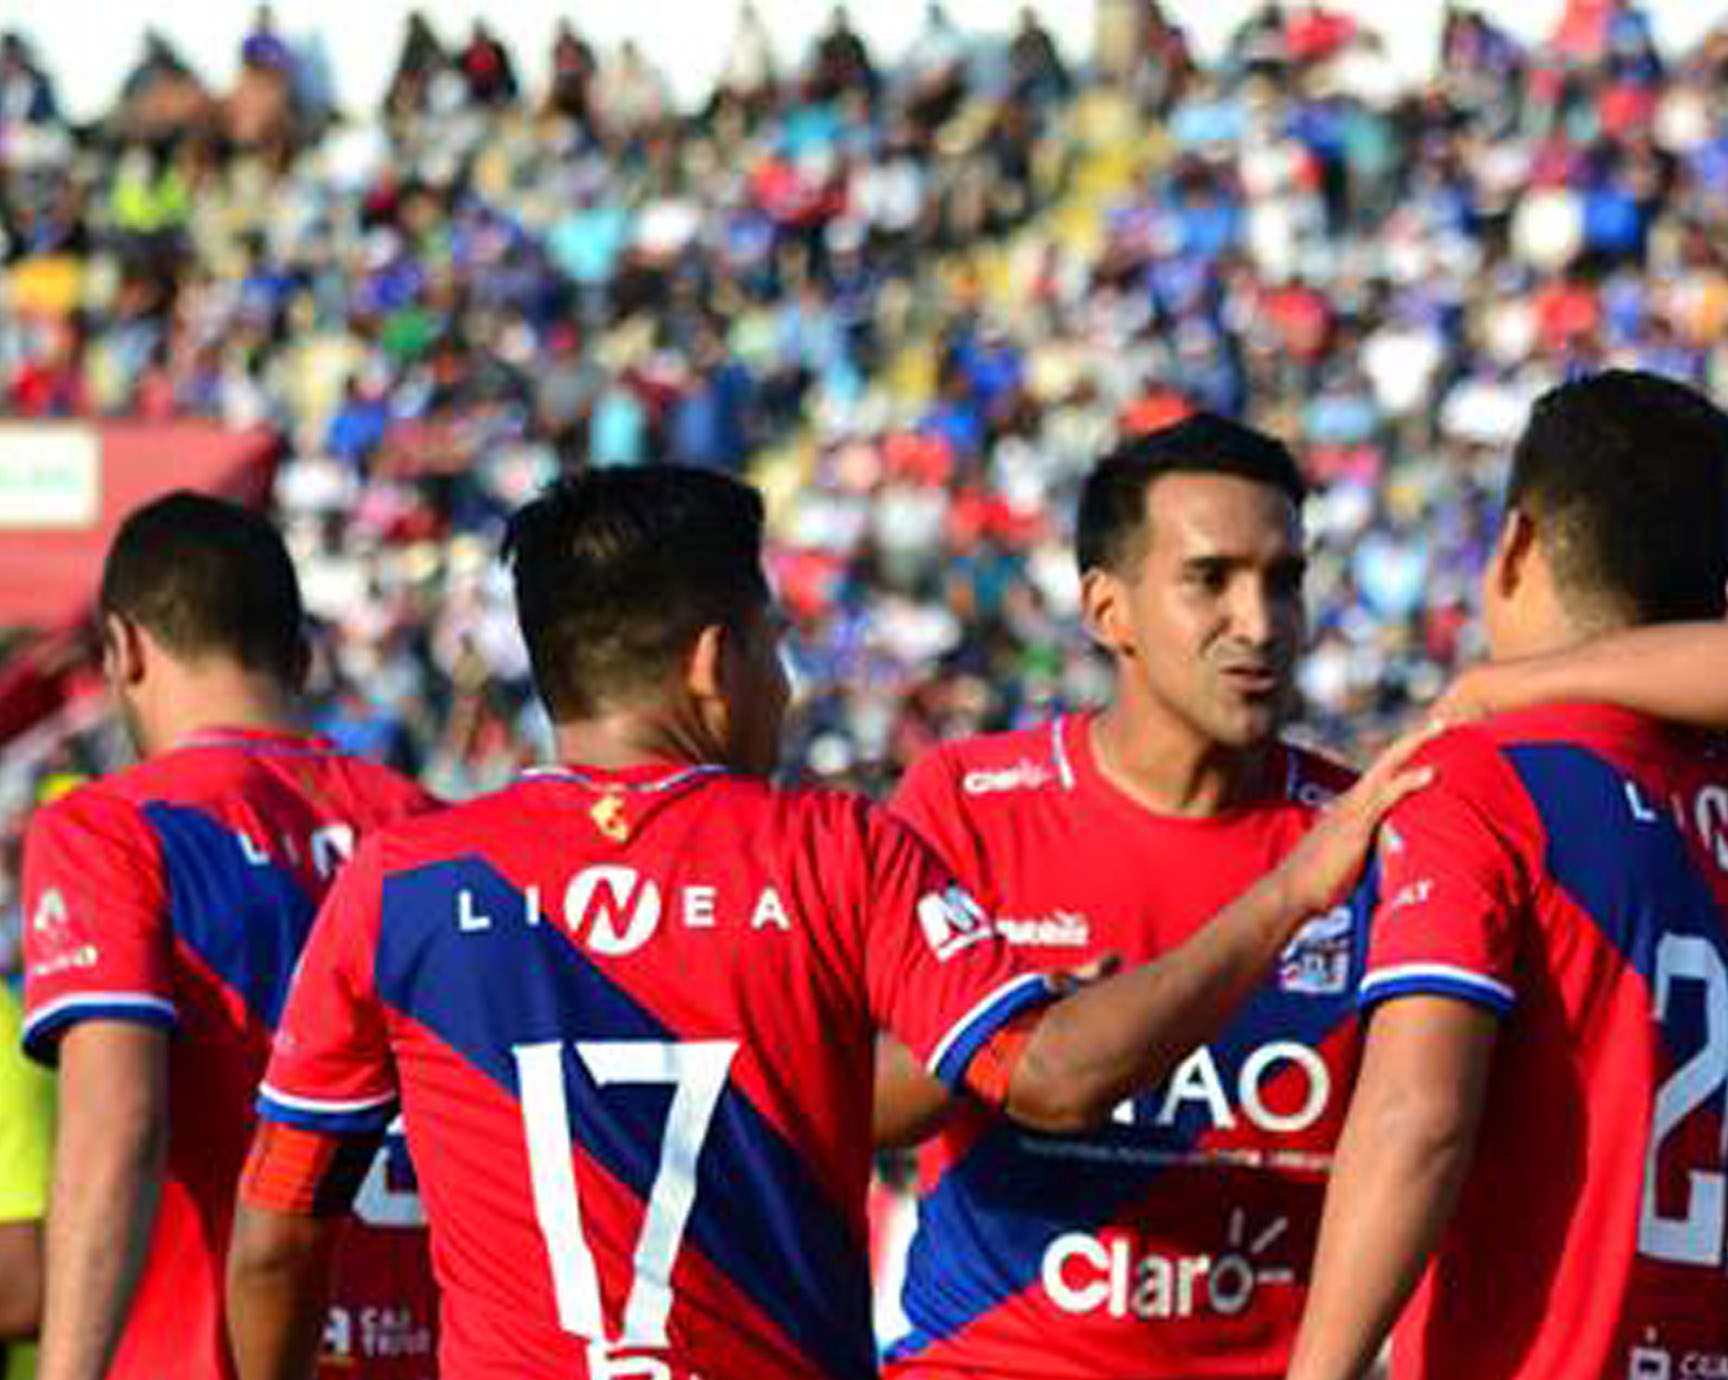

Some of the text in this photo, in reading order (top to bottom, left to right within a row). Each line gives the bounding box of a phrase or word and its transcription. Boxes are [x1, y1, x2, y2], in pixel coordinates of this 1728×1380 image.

[457, 865, 790, 955] LINEA
[512, 1040, 740, 1348] 17
[1041, 1230, 1257, 1319] Claro
